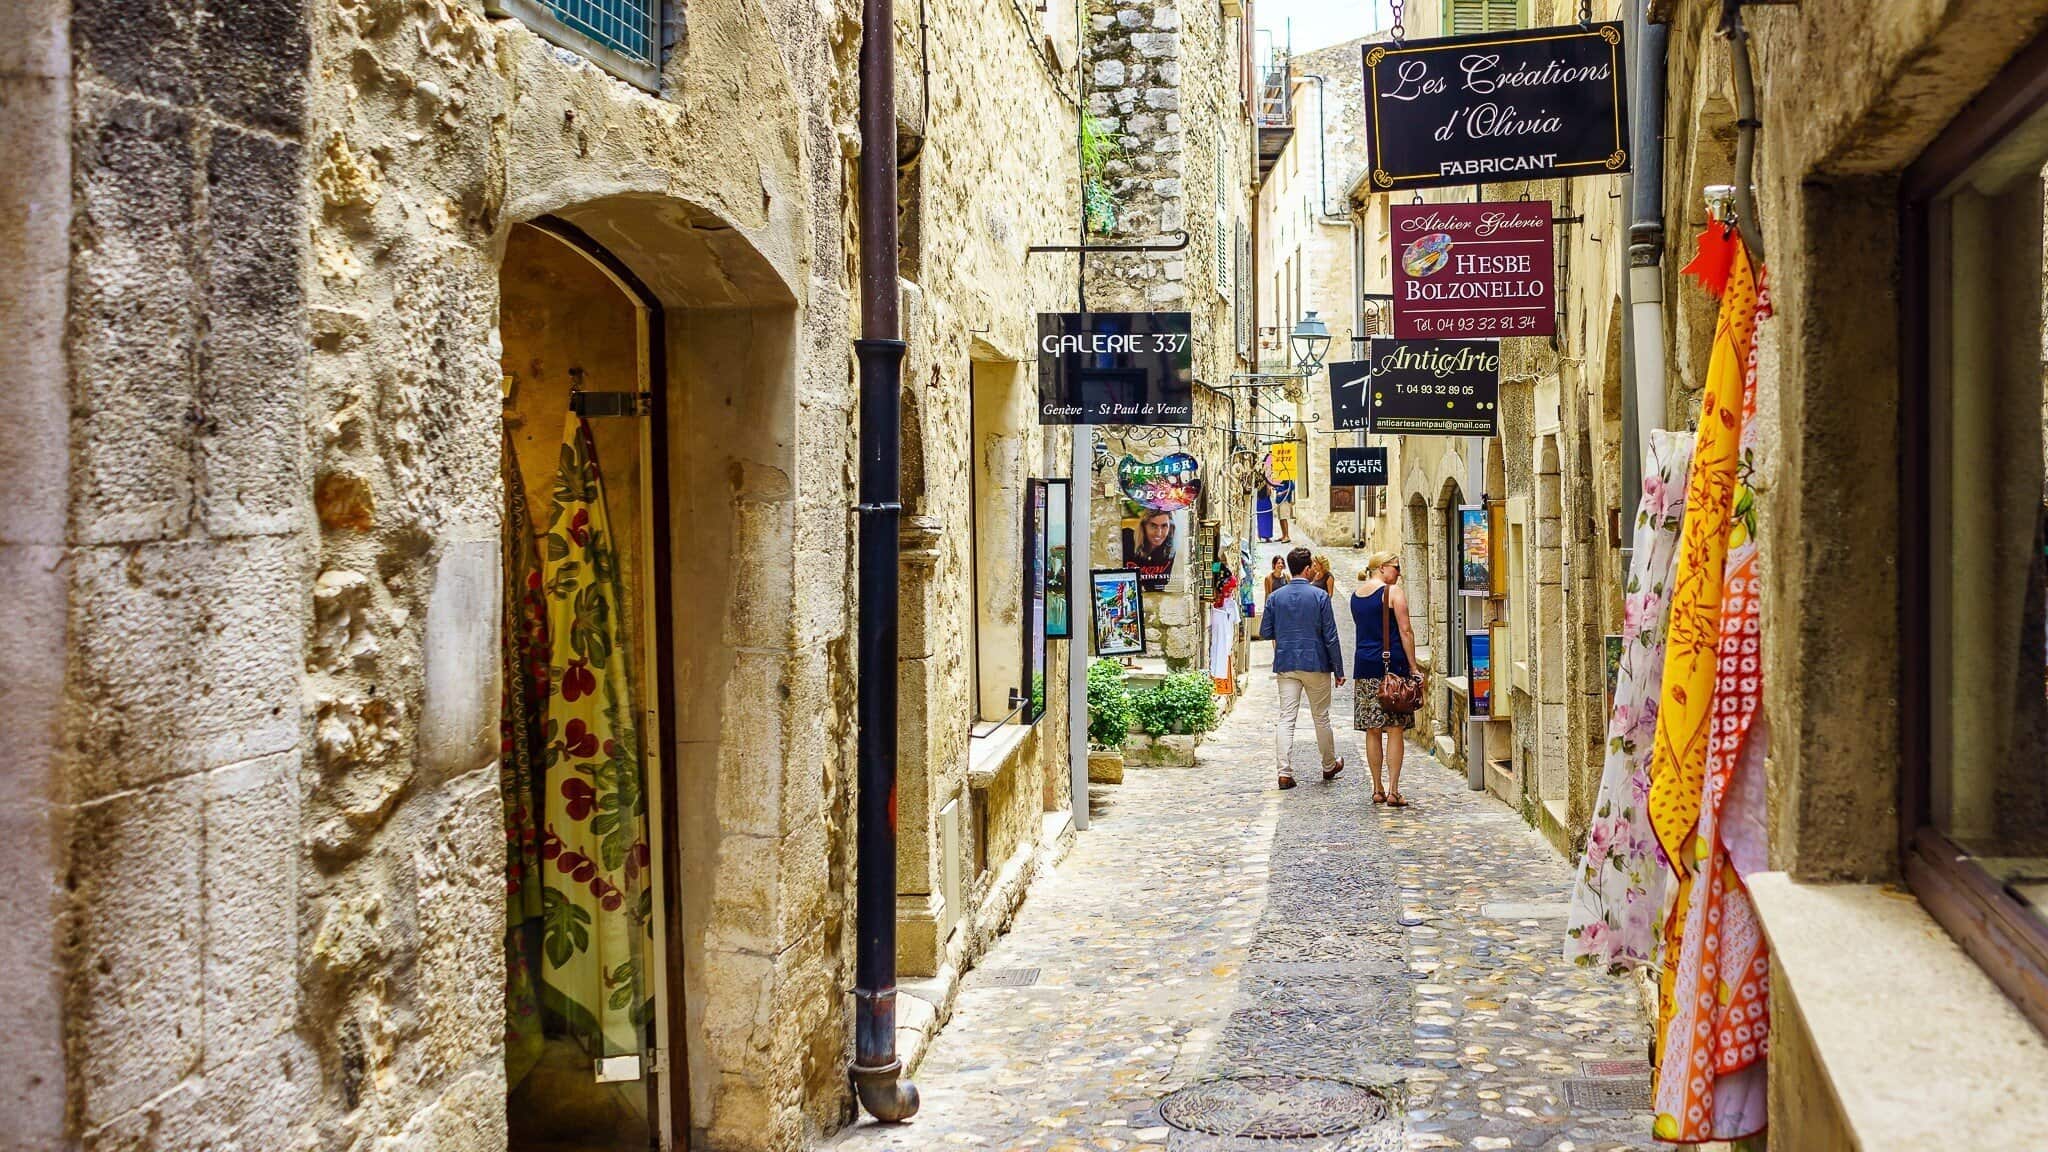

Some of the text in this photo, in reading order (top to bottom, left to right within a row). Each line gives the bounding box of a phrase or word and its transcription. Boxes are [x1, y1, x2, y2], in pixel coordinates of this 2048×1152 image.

[1381, 54, 1611, 101] Les Créations
[1434, 102, 1562, 142] d'Olivia
[1440, 153, 1557, 177] FABRICANT
[1401, 211, 1544, 237] Atelier Galerie
[1455, 254, 1531, 275] HESBE
[1405, 280, 1544, 301] BOLZONELLO
[1437, 317, 1454, 331] 04
[1458, 317, 1475, 330] 93
[1477, 316, 1496, 330] 32
[1500, 316, 1514, 329] 81
[1517, 315, 1536, 329] 34
[1042, 333, 1188, 358] GALERIE 337
[1396, 384, 1474, 395] T. 04 93 32 89 05
[1043, 403, 1083, 416] Genève
[1099, 403, 1111, 415] St
[1113, 403, 1139, 415] Paul
[1141, 403, 1154, 415] de
[1157, 403, 1188, 415] Vence
[1122, 459, 1191, 475] ATELIER
[1335, 466, 1382, 474] MORIN
[1336, 459, 1382, 467] ATELIER
